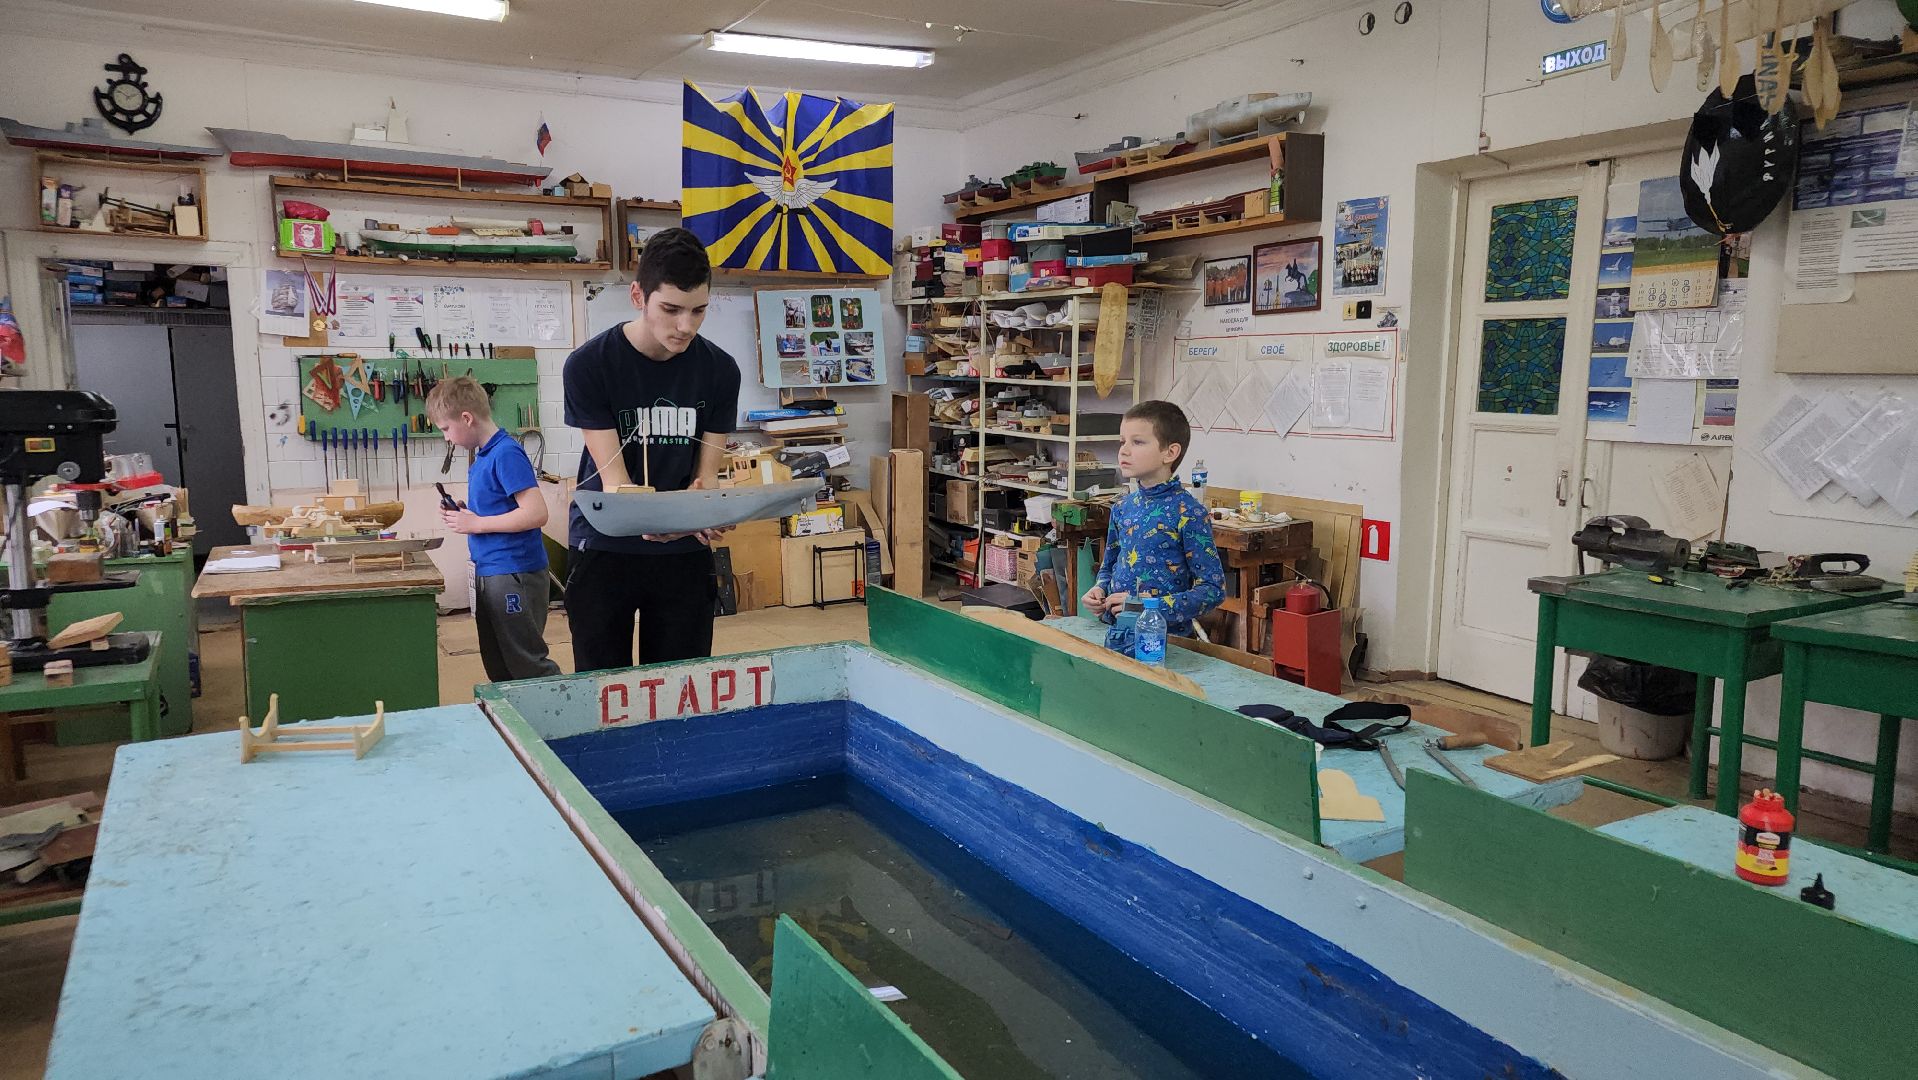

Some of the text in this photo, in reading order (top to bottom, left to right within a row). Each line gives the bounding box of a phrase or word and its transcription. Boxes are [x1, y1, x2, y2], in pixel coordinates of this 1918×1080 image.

[1545, 43, 1605, 73] ВЫХОД
[1188, 340, 1386, 356] БЕРЕГИ СВОЁ ЗДОРОВЬЕ!
[619, 406, 697, 438] PUMA
[658, 437, 690, 446] FASTER
[505, 593, 522, 613] R
[600, 665, 770, 724] СТАРТ
